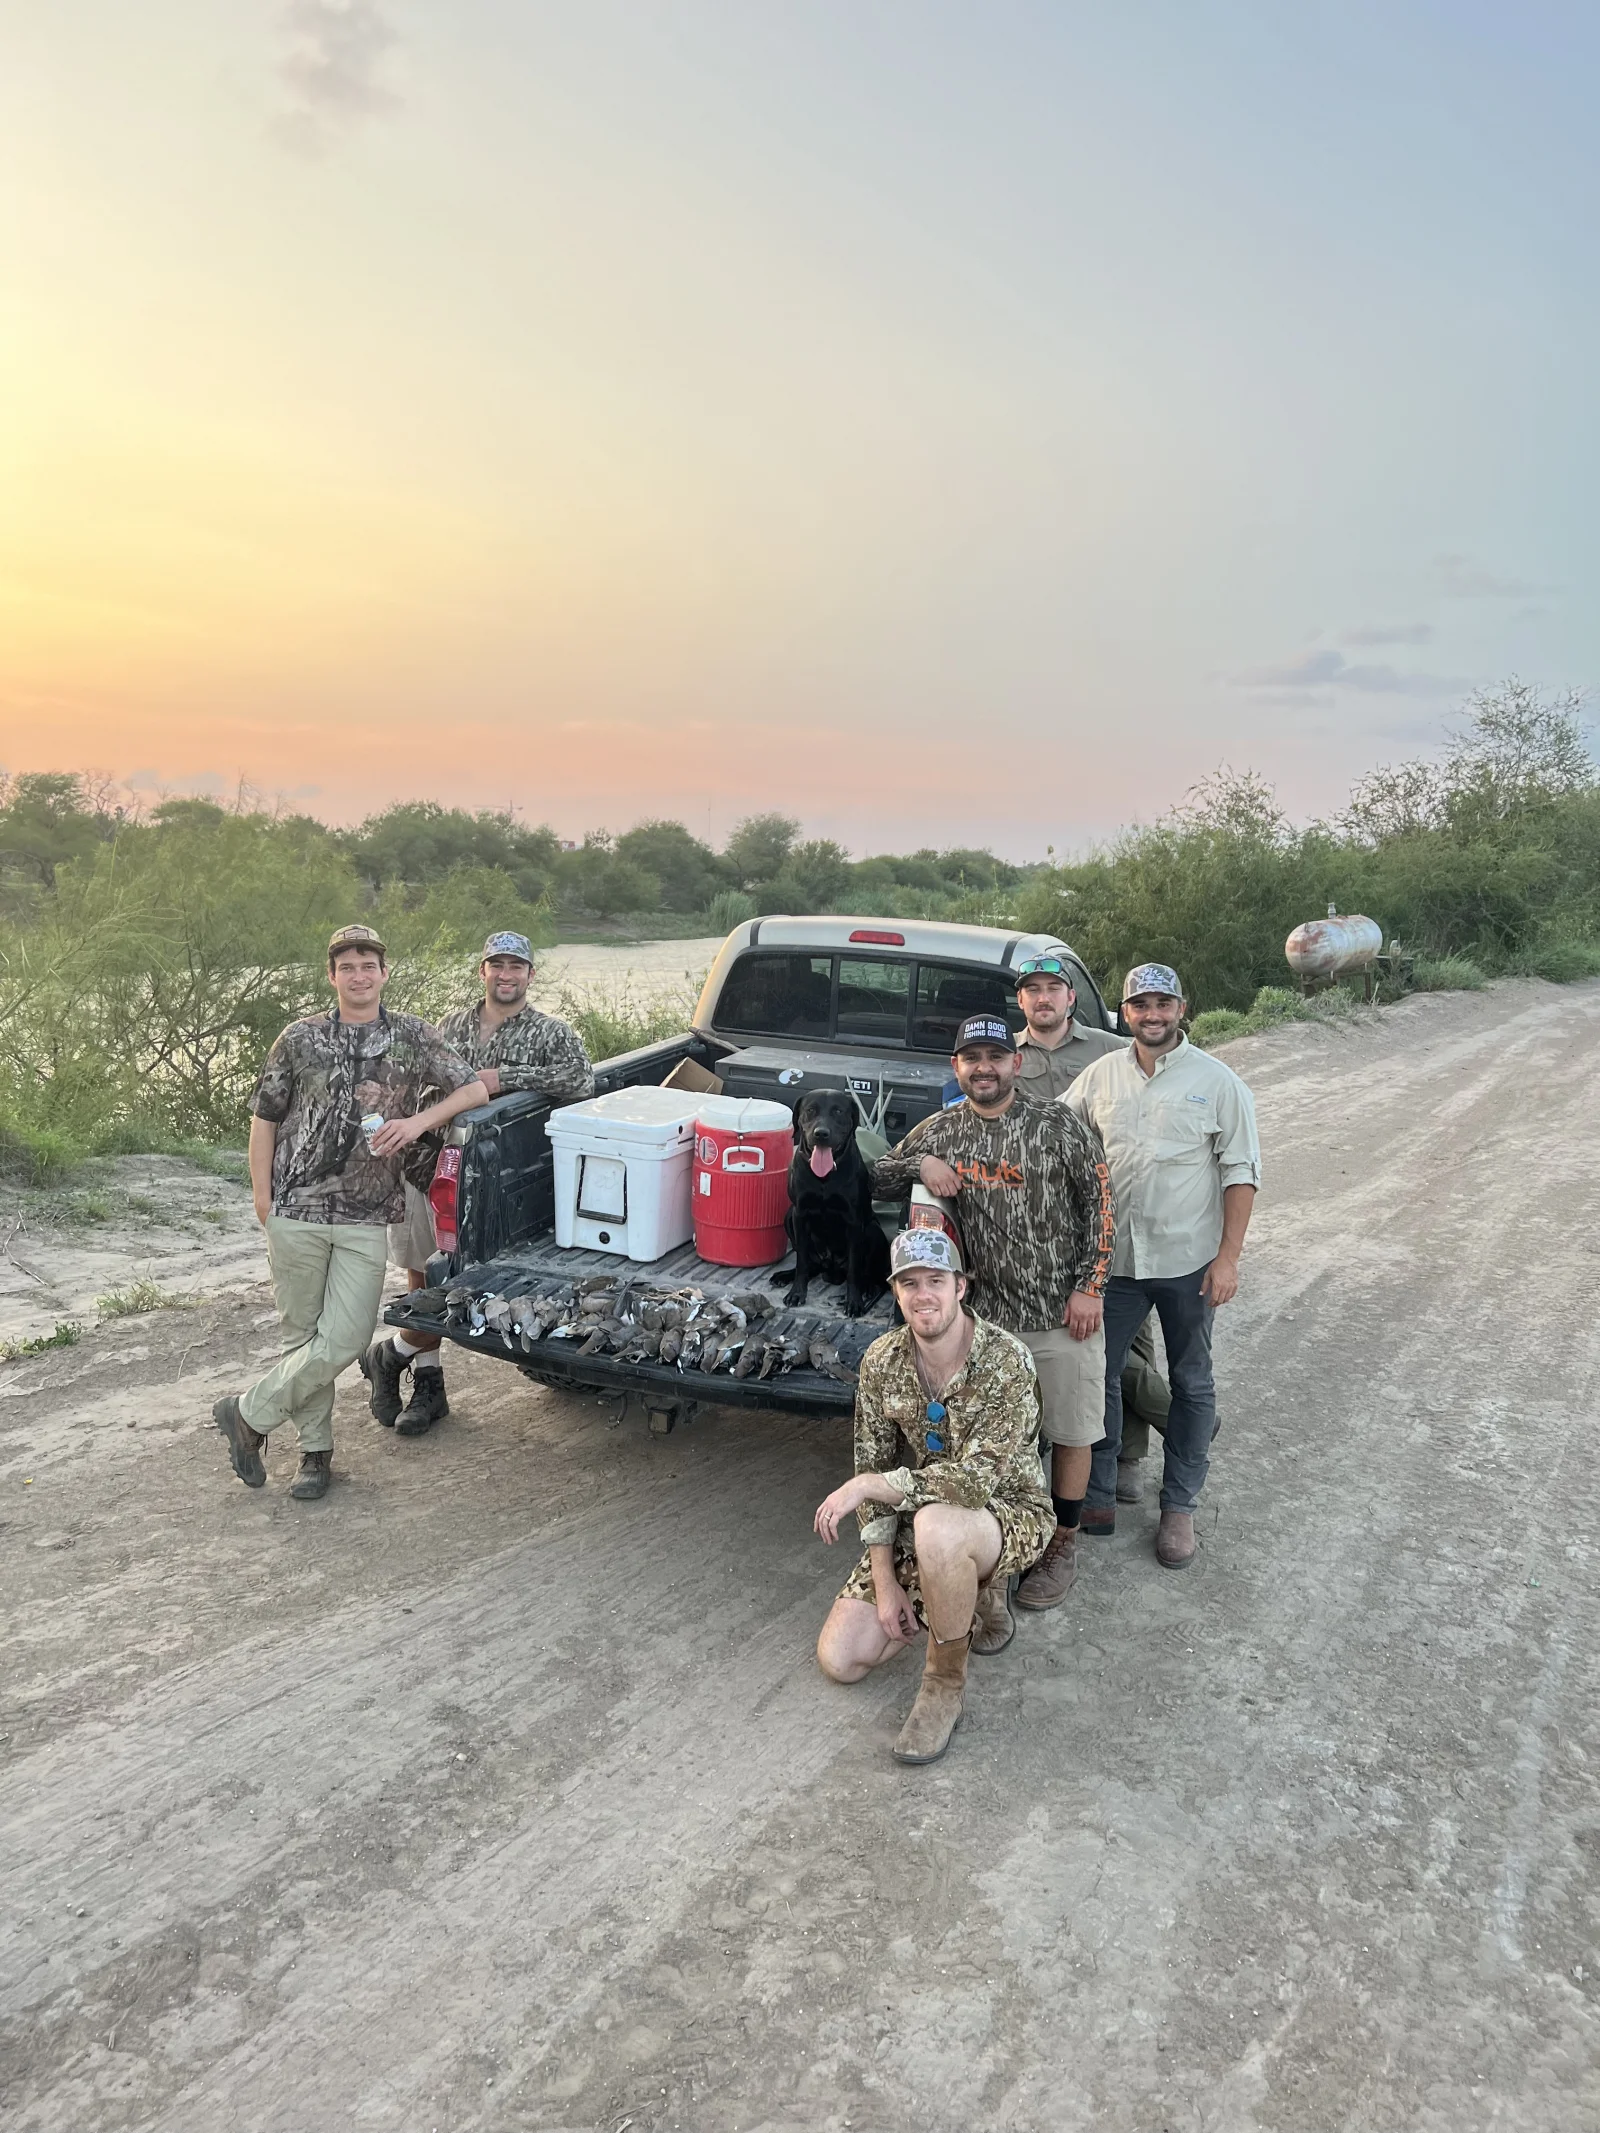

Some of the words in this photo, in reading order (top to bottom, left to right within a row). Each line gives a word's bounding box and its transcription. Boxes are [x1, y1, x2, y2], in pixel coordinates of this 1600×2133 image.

[965, 1021, 985, 1032] DAMN
[988, 1021, 1006, 1032] GOOD
[964, 1030, 986, 1040] FISHING
[987, 1030, 1007, 1040] GUIDES
